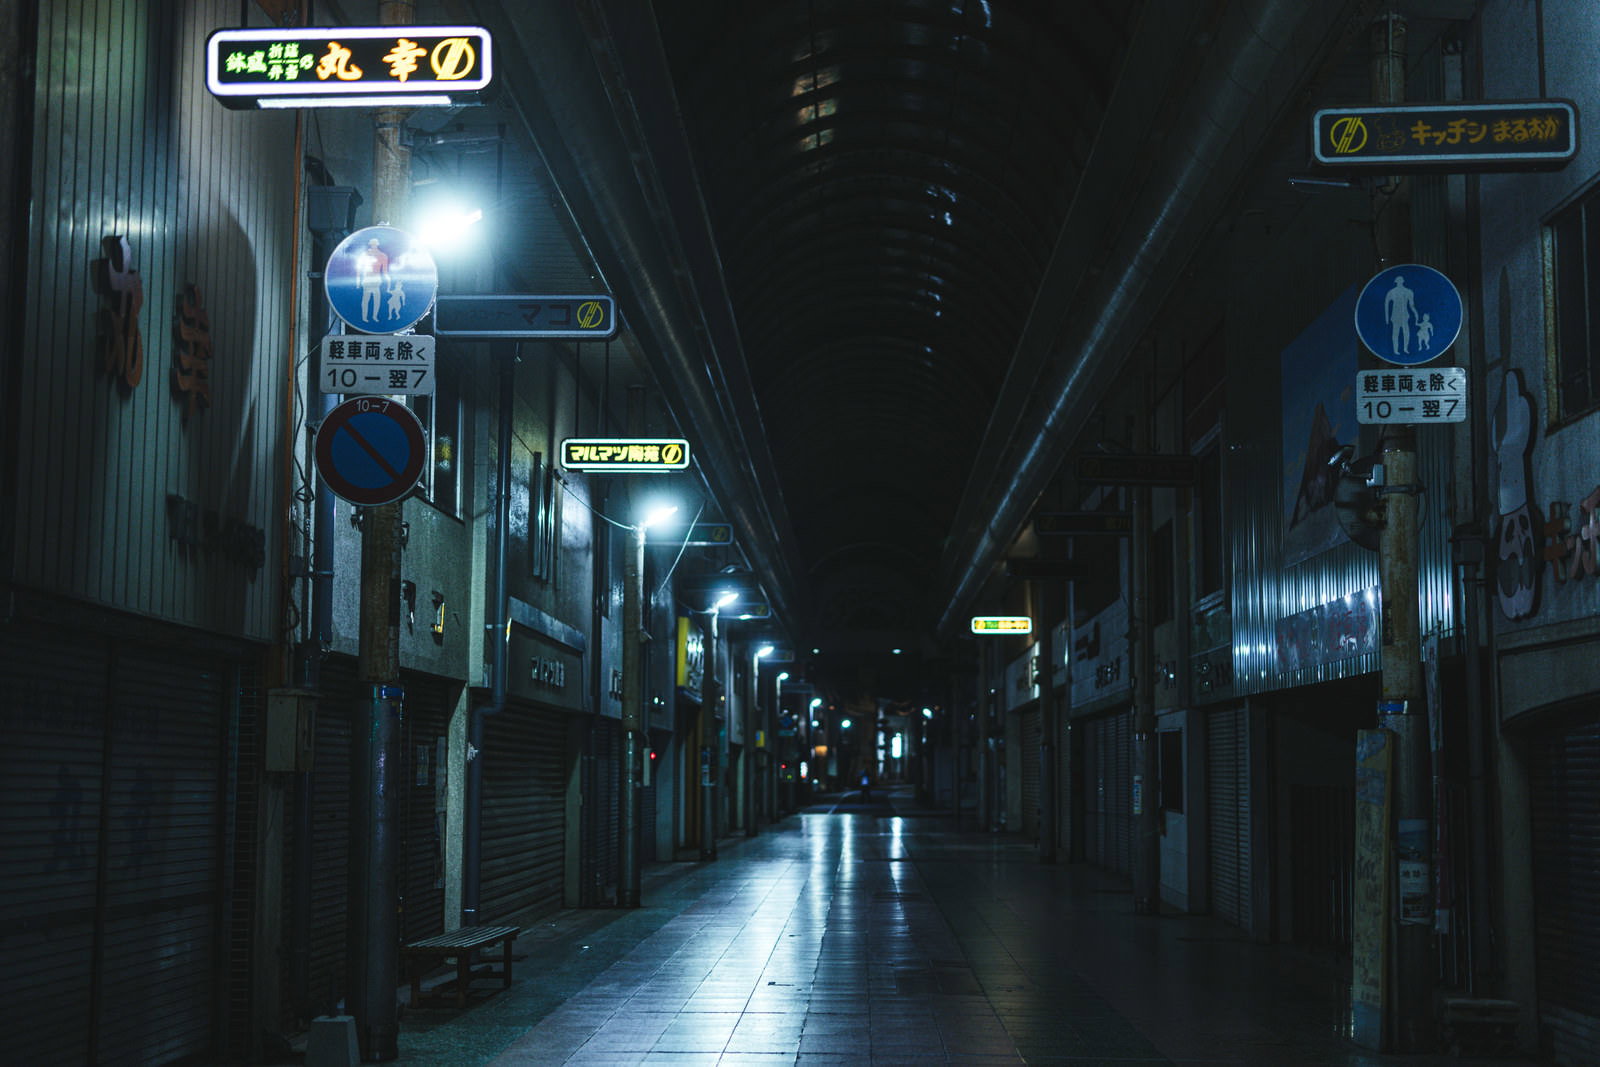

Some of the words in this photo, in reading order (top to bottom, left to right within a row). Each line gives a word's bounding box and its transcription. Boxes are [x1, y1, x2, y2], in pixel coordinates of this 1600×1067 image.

[1410, 118, 1488, 146] キッチン
[1493, 115, 1561, 145] まるおか
[518, 303, 571, 326] マコ
[329, 341, 426, 361] 軽車両を除く
[1364, 374, 1457, 393] 軽車両を除く
[356, 400, 391, 413] 10-7
